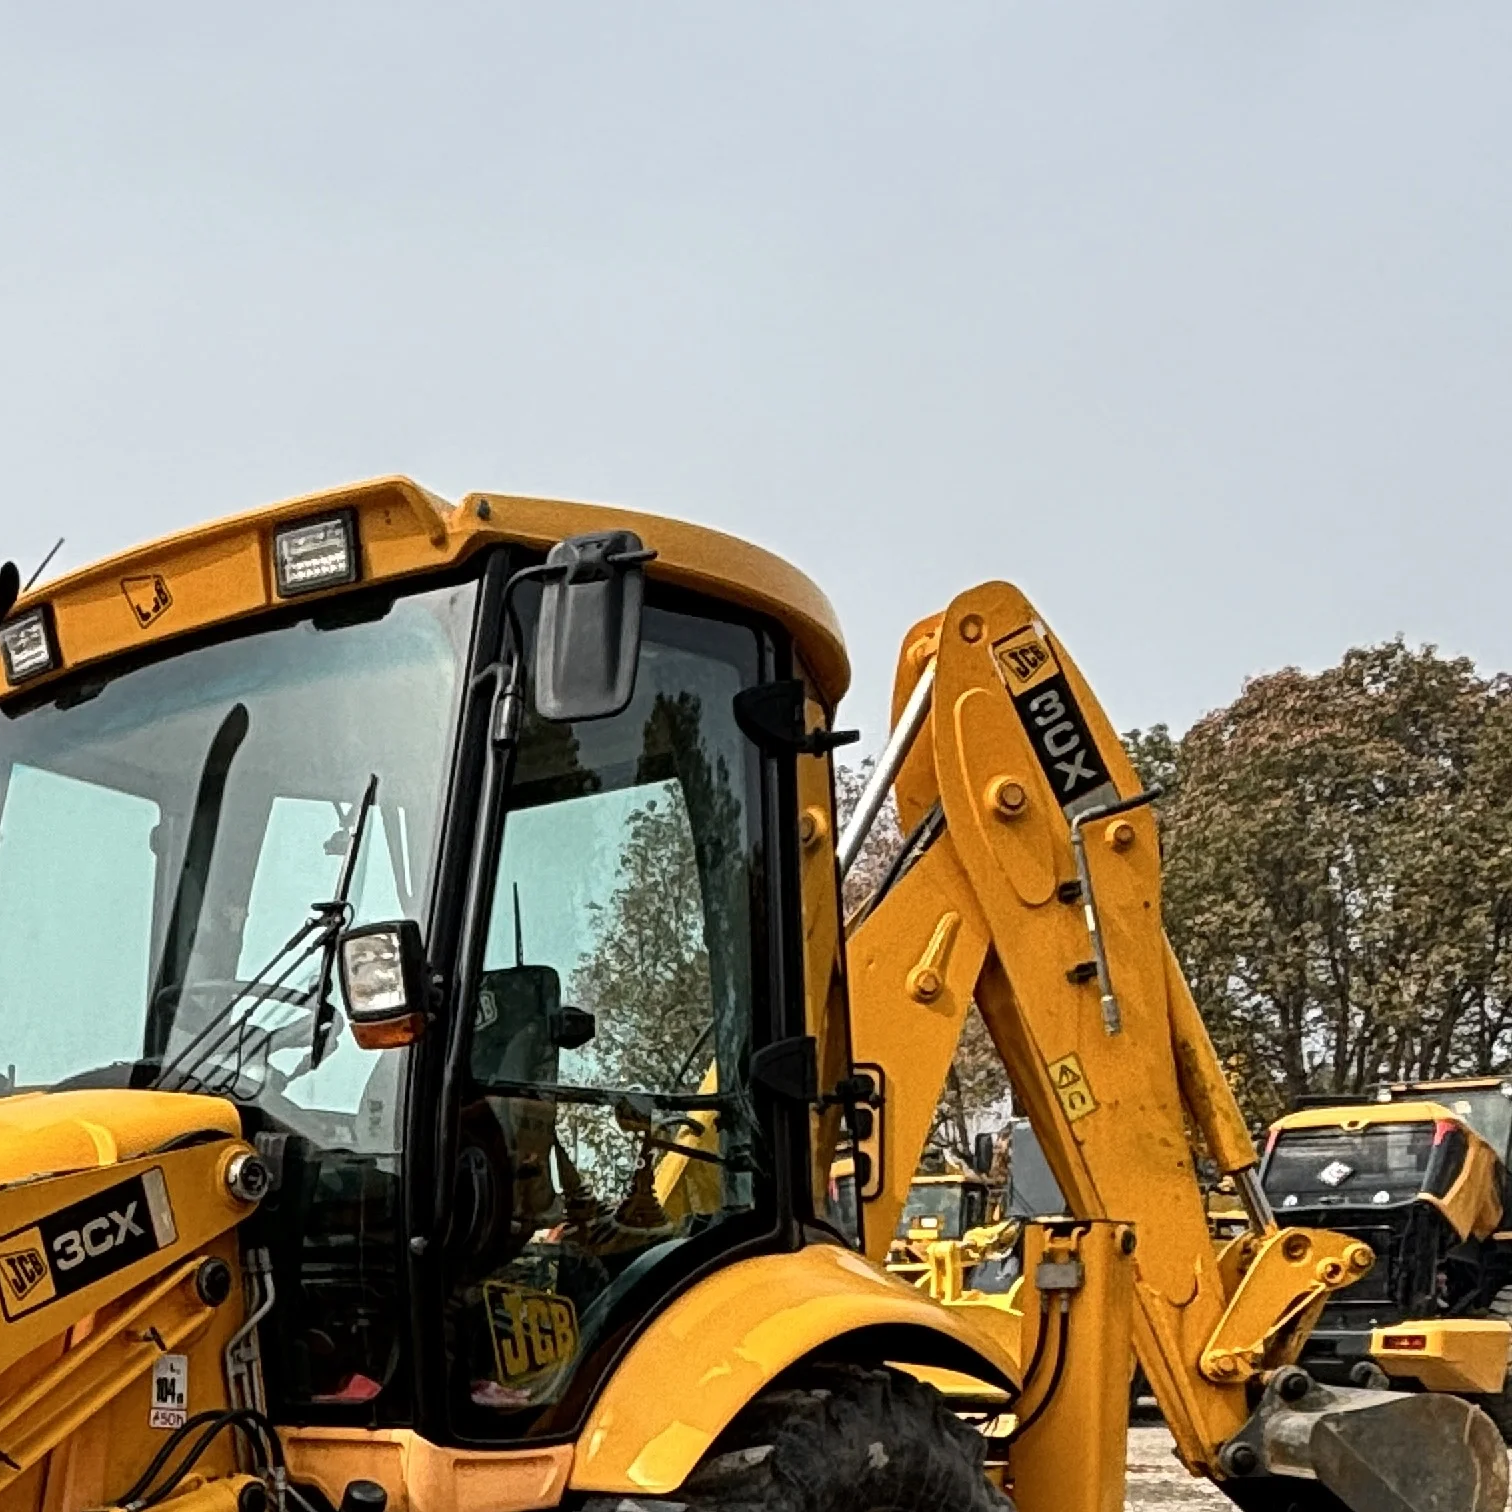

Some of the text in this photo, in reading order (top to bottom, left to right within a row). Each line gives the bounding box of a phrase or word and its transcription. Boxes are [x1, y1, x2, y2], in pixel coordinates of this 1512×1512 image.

[1007, 643, 1048, 679] JCB
[1029, 689, 1099, 793] 3CX
[52, 1200, 146, 1272] 3CX
[3, 1251, 46, 1295] JCB
[500, 1291, 576, 1376] JCB
